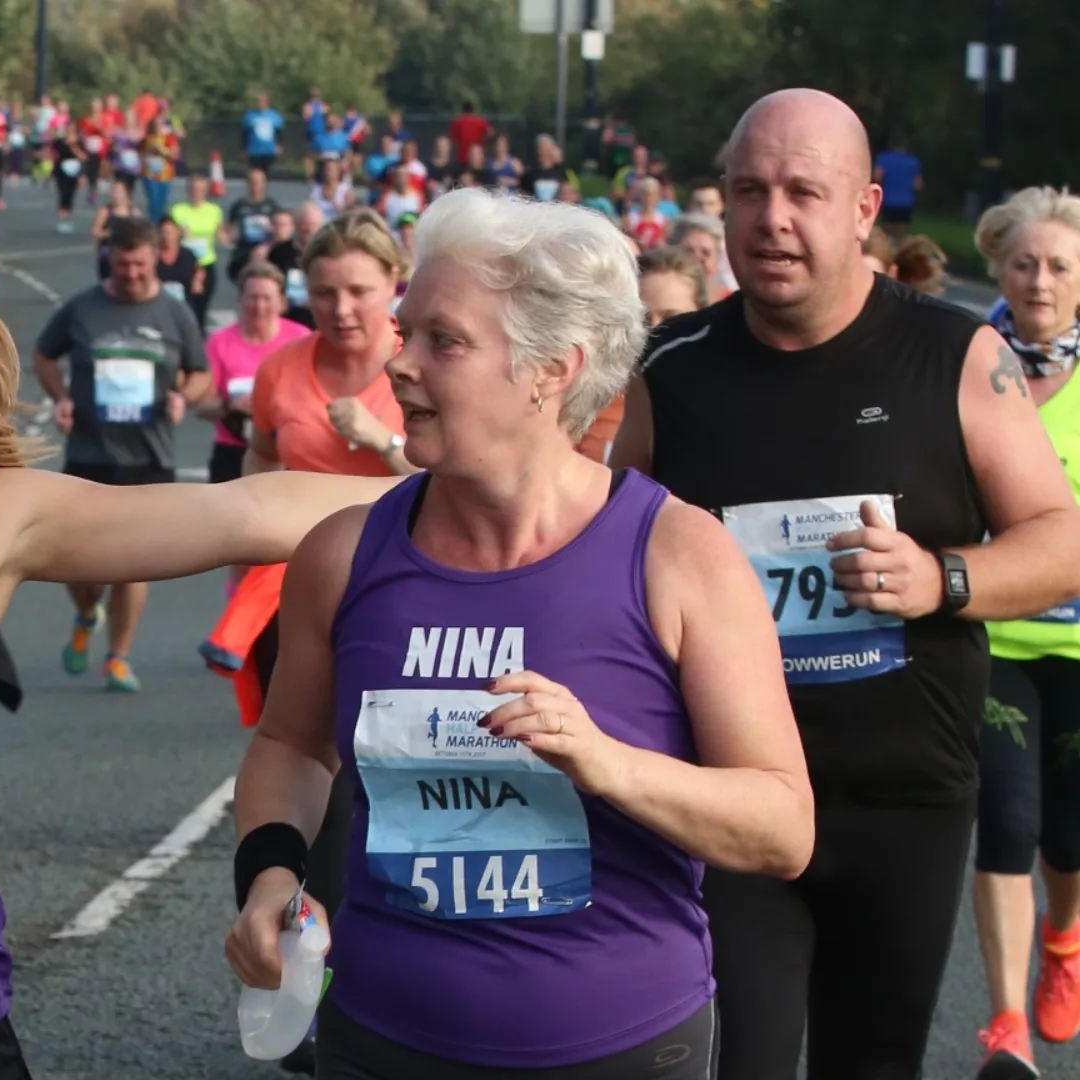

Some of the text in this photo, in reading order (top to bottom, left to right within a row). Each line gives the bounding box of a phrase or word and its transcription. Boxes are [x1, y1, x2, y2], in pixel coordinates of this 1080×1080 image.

[402, 627, 524, 678] NINA
[446, 735, 518, 748] MARATHON
[416, 776, 529, 810] NINA
[411, 854, 543, 914] 5144
